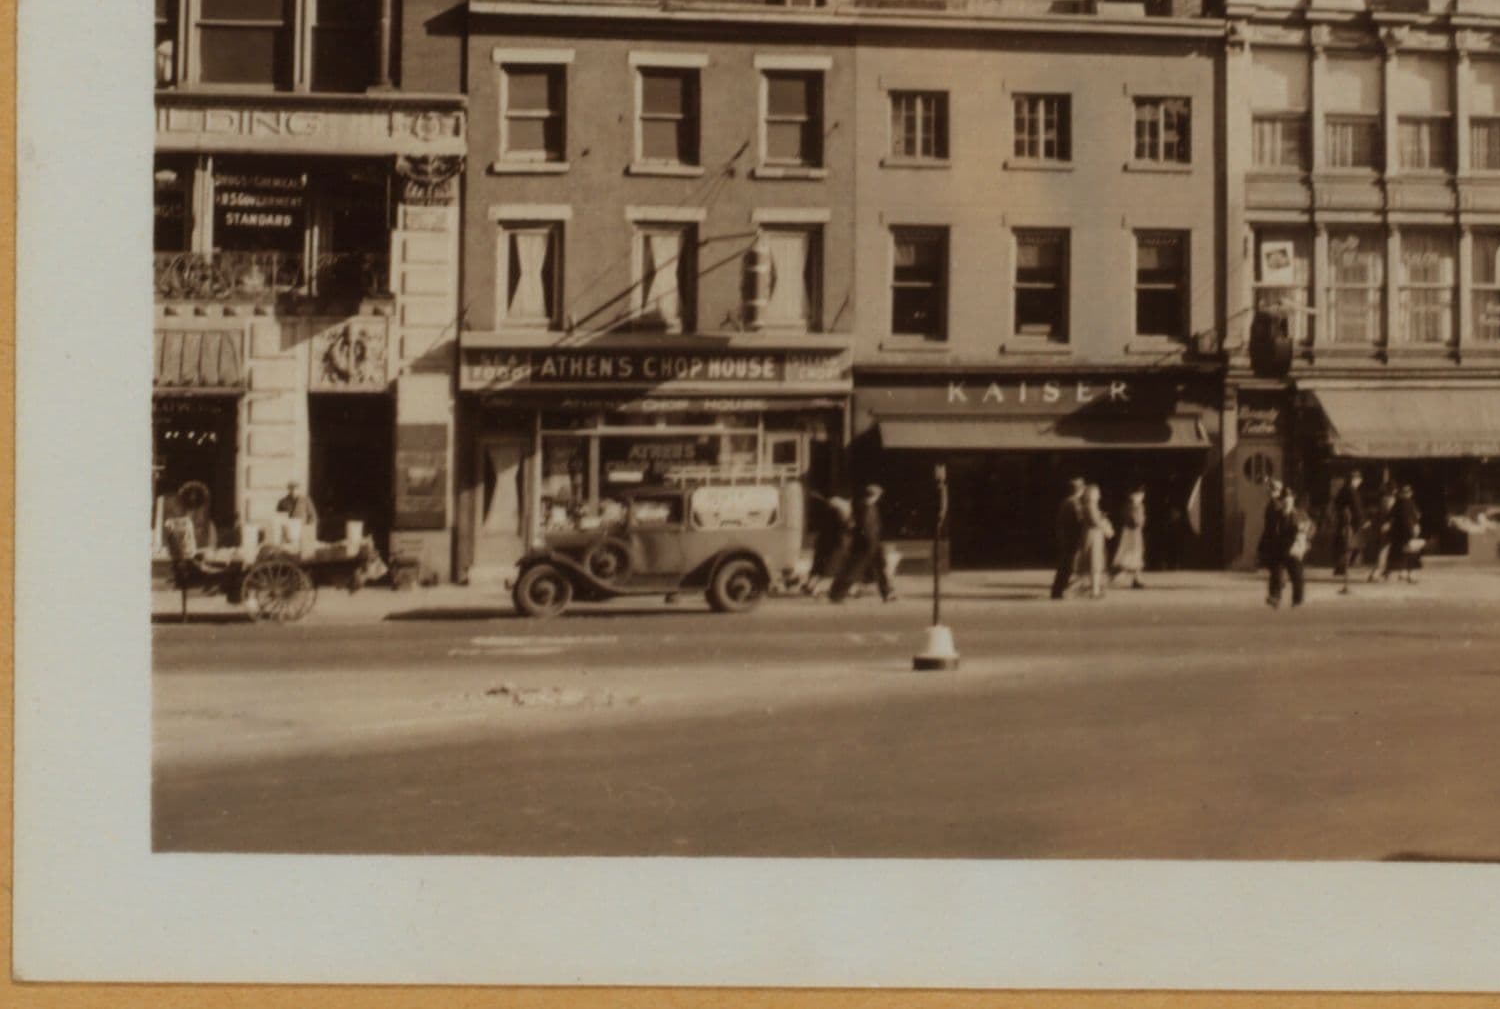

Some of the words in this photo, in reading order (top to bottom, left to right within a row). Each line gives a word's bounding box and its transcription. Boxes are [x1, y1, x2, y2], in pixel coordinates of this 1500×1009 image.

[225, 212, 293, 228] STANDARD
[642, 355, 704, 379] CHOP
[707, 355, 776, 379] HOUSE
[947, 380, 1132, 404] KAISER
